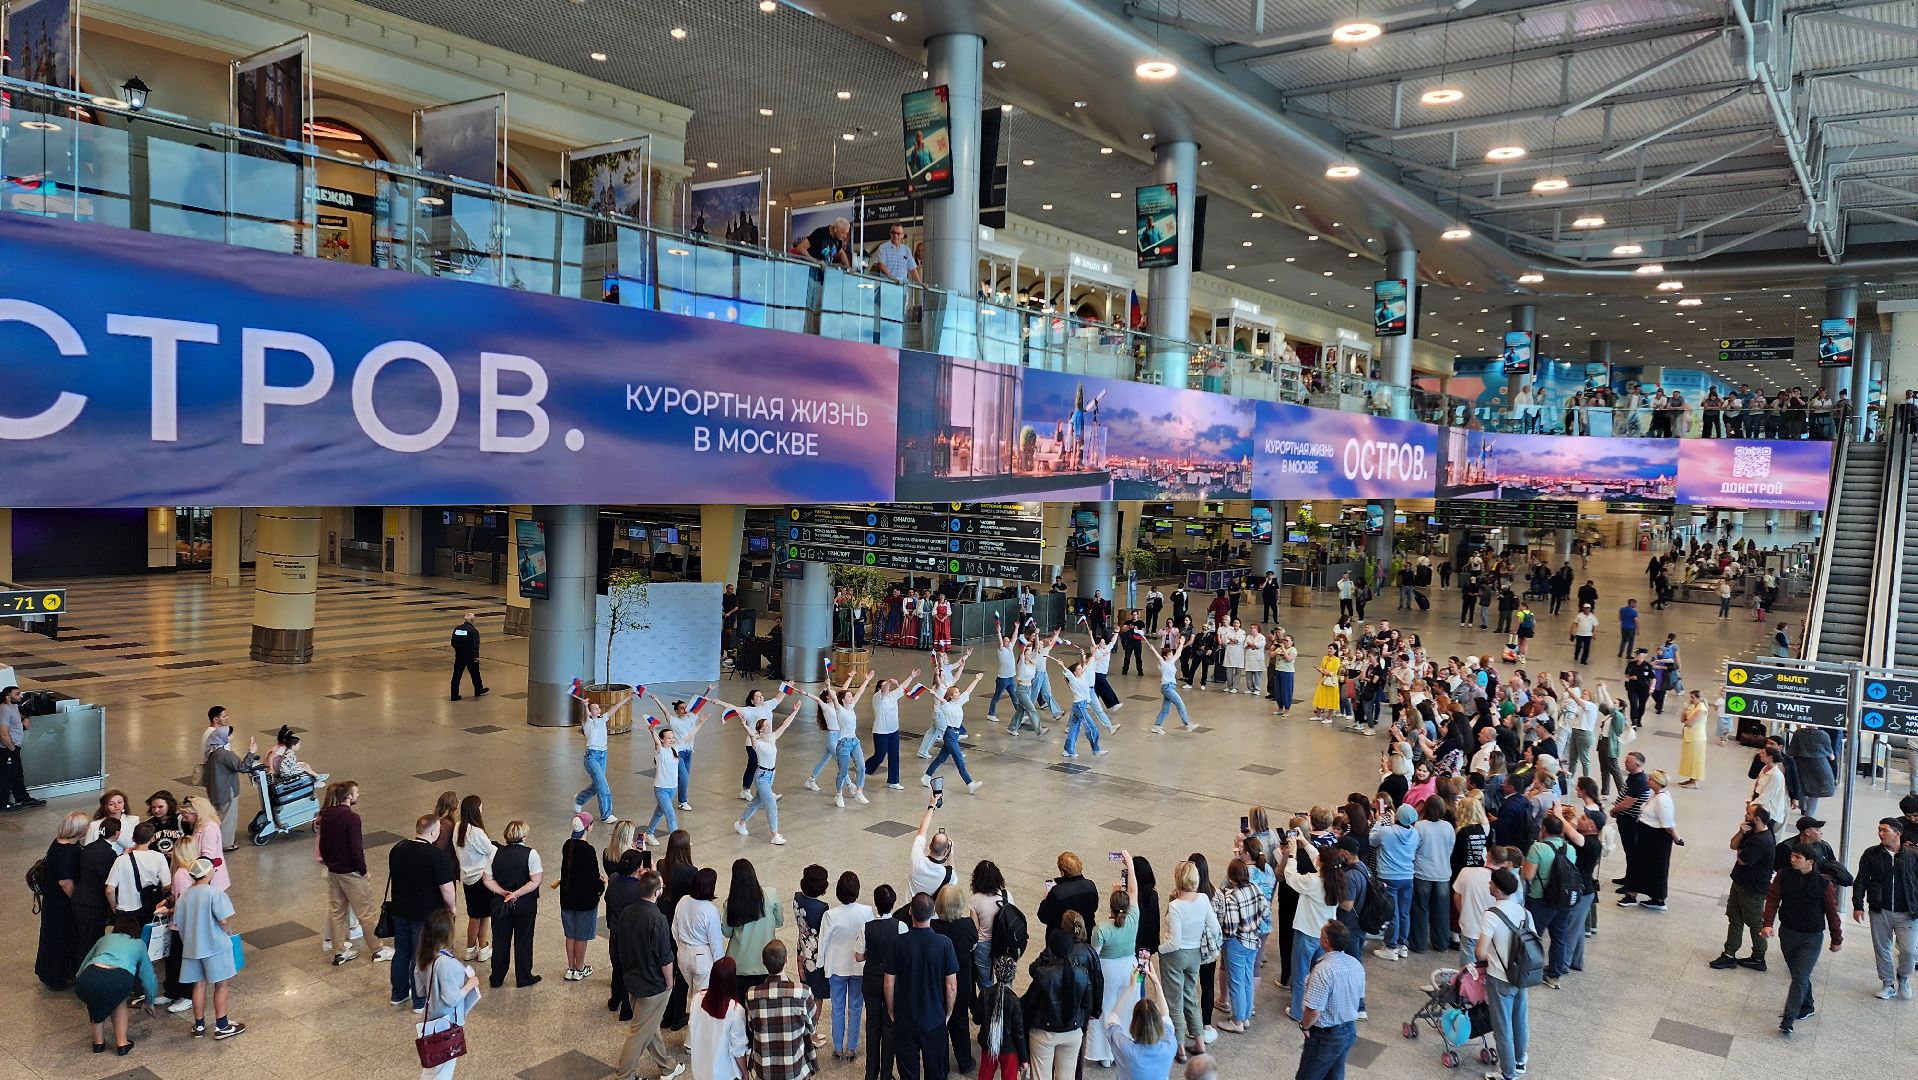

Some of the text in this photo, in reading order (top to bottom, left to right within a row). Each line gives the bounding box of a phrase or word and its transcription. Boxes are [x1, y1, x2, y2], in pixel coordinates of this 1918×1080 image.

[625, 383, 870, 429] КУРОРТНАЯ ЖИЗНЬ
[694, 426, 819, 456] В МОСКВЕ
[1264, 439, 1334, 458] КУРОРТНАЯ ЖИЗНЬ
[1281, 459, 1319, 474] В МОСКВЕ
[1343, 437, 1428, 482] ОСТРОВ.
[1720, 481, 1783, 495] ДОНСТРОЙ
[14, 597, 35, 610] 71
[1776, 673, 1809, 684] ВЫЛЕТ
[1776, 684, 1810, 692] DEPARTURES
[1776, 702, 1811, 714] ТУАЛЕТ
[1775, 712, 1794, 720] TOILET
